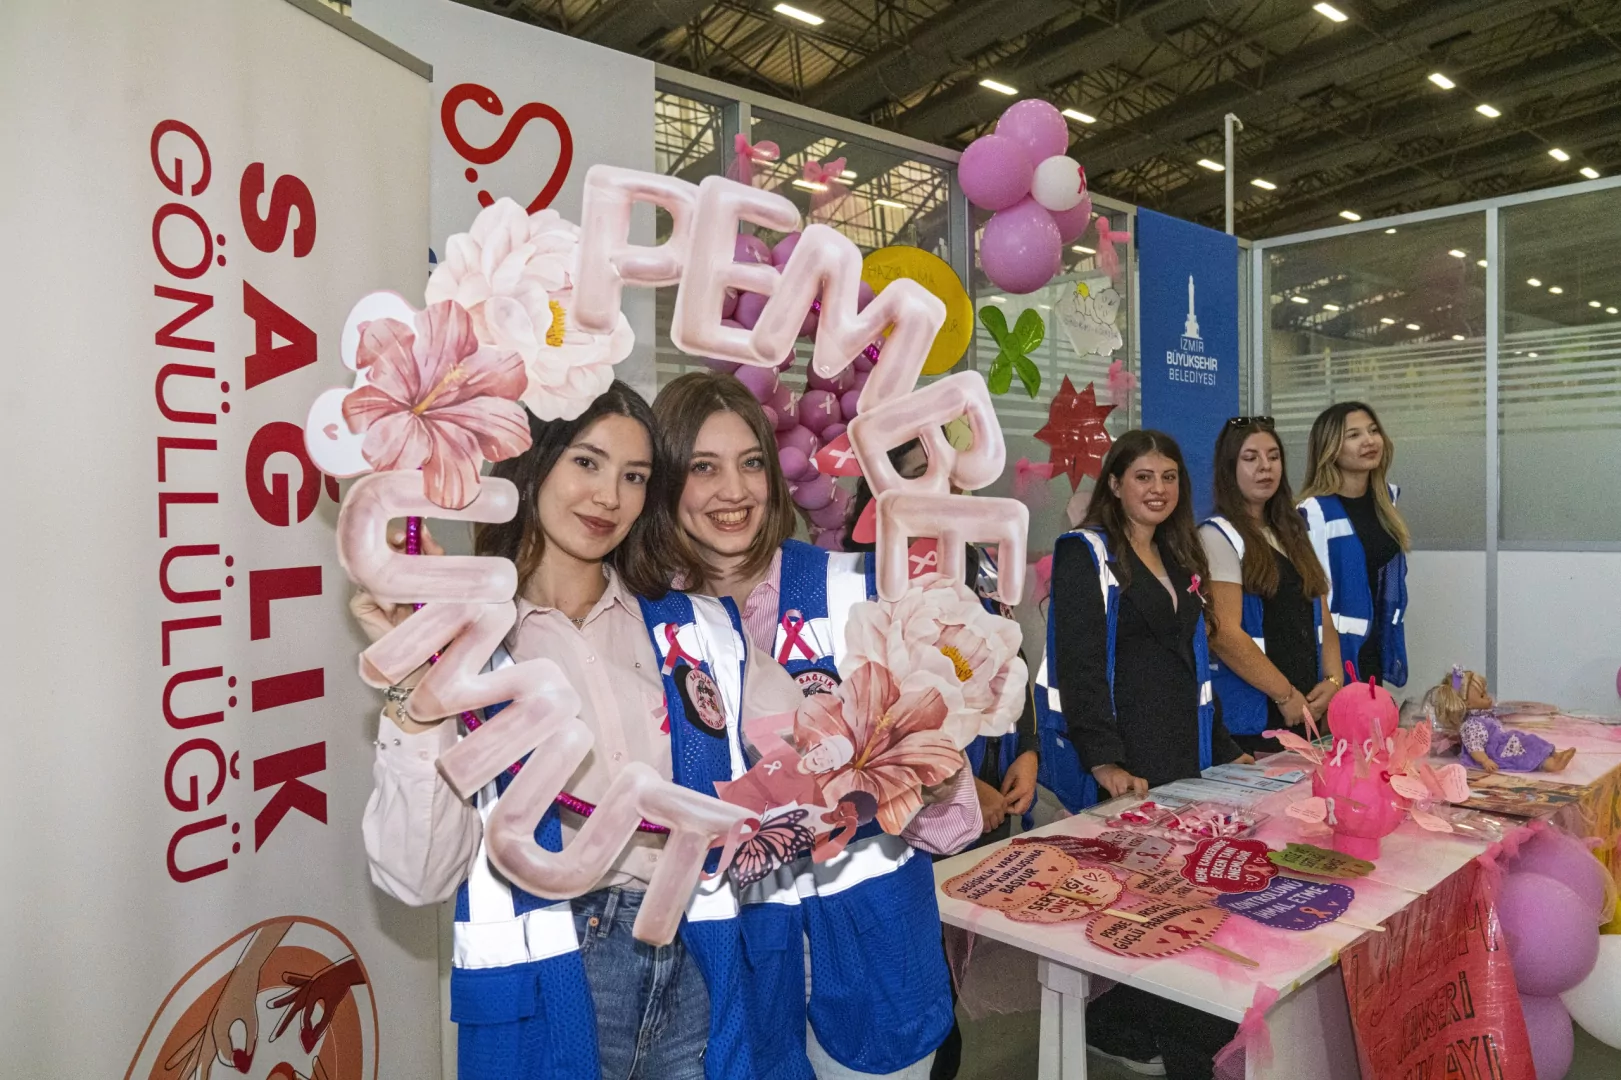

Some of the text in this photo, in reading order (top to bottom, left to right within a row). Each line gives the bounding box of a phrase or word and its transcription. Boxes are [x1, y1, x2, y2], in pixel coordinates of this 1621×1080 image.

[1180, 338, 1204, 352] İZMİR
[1166, 350, 1218, 371] BÜYÜKŞEHİR
[1169, 368, 1216, 386] BELEDİYESİ
[150, 119, 241, 883] GÖNÜLLÜLÜĞÜ
[240, 162, 339, 853] SAĞLIK
[799, 674, 834, 689] SAĞLIK
[956, 850, 1025, 894] DEĞİŞİKLİK VARSA
[967, 882, 999, 900] SAĞLIK
[995, 849, 1045, 885] KURULUŞUNA
[1210, 859, 1229, 878] ERKEN
[999, 867, 1039, 895] BAŞVUR
[1227, 879, 1304, 910] KONTROLÜNÜ
[1287, 885, 1329, 904] ETME
[1100, 920, 1132, 939] PEMBE
[1113, 928, 1146, 950] GÜÇLÜ
